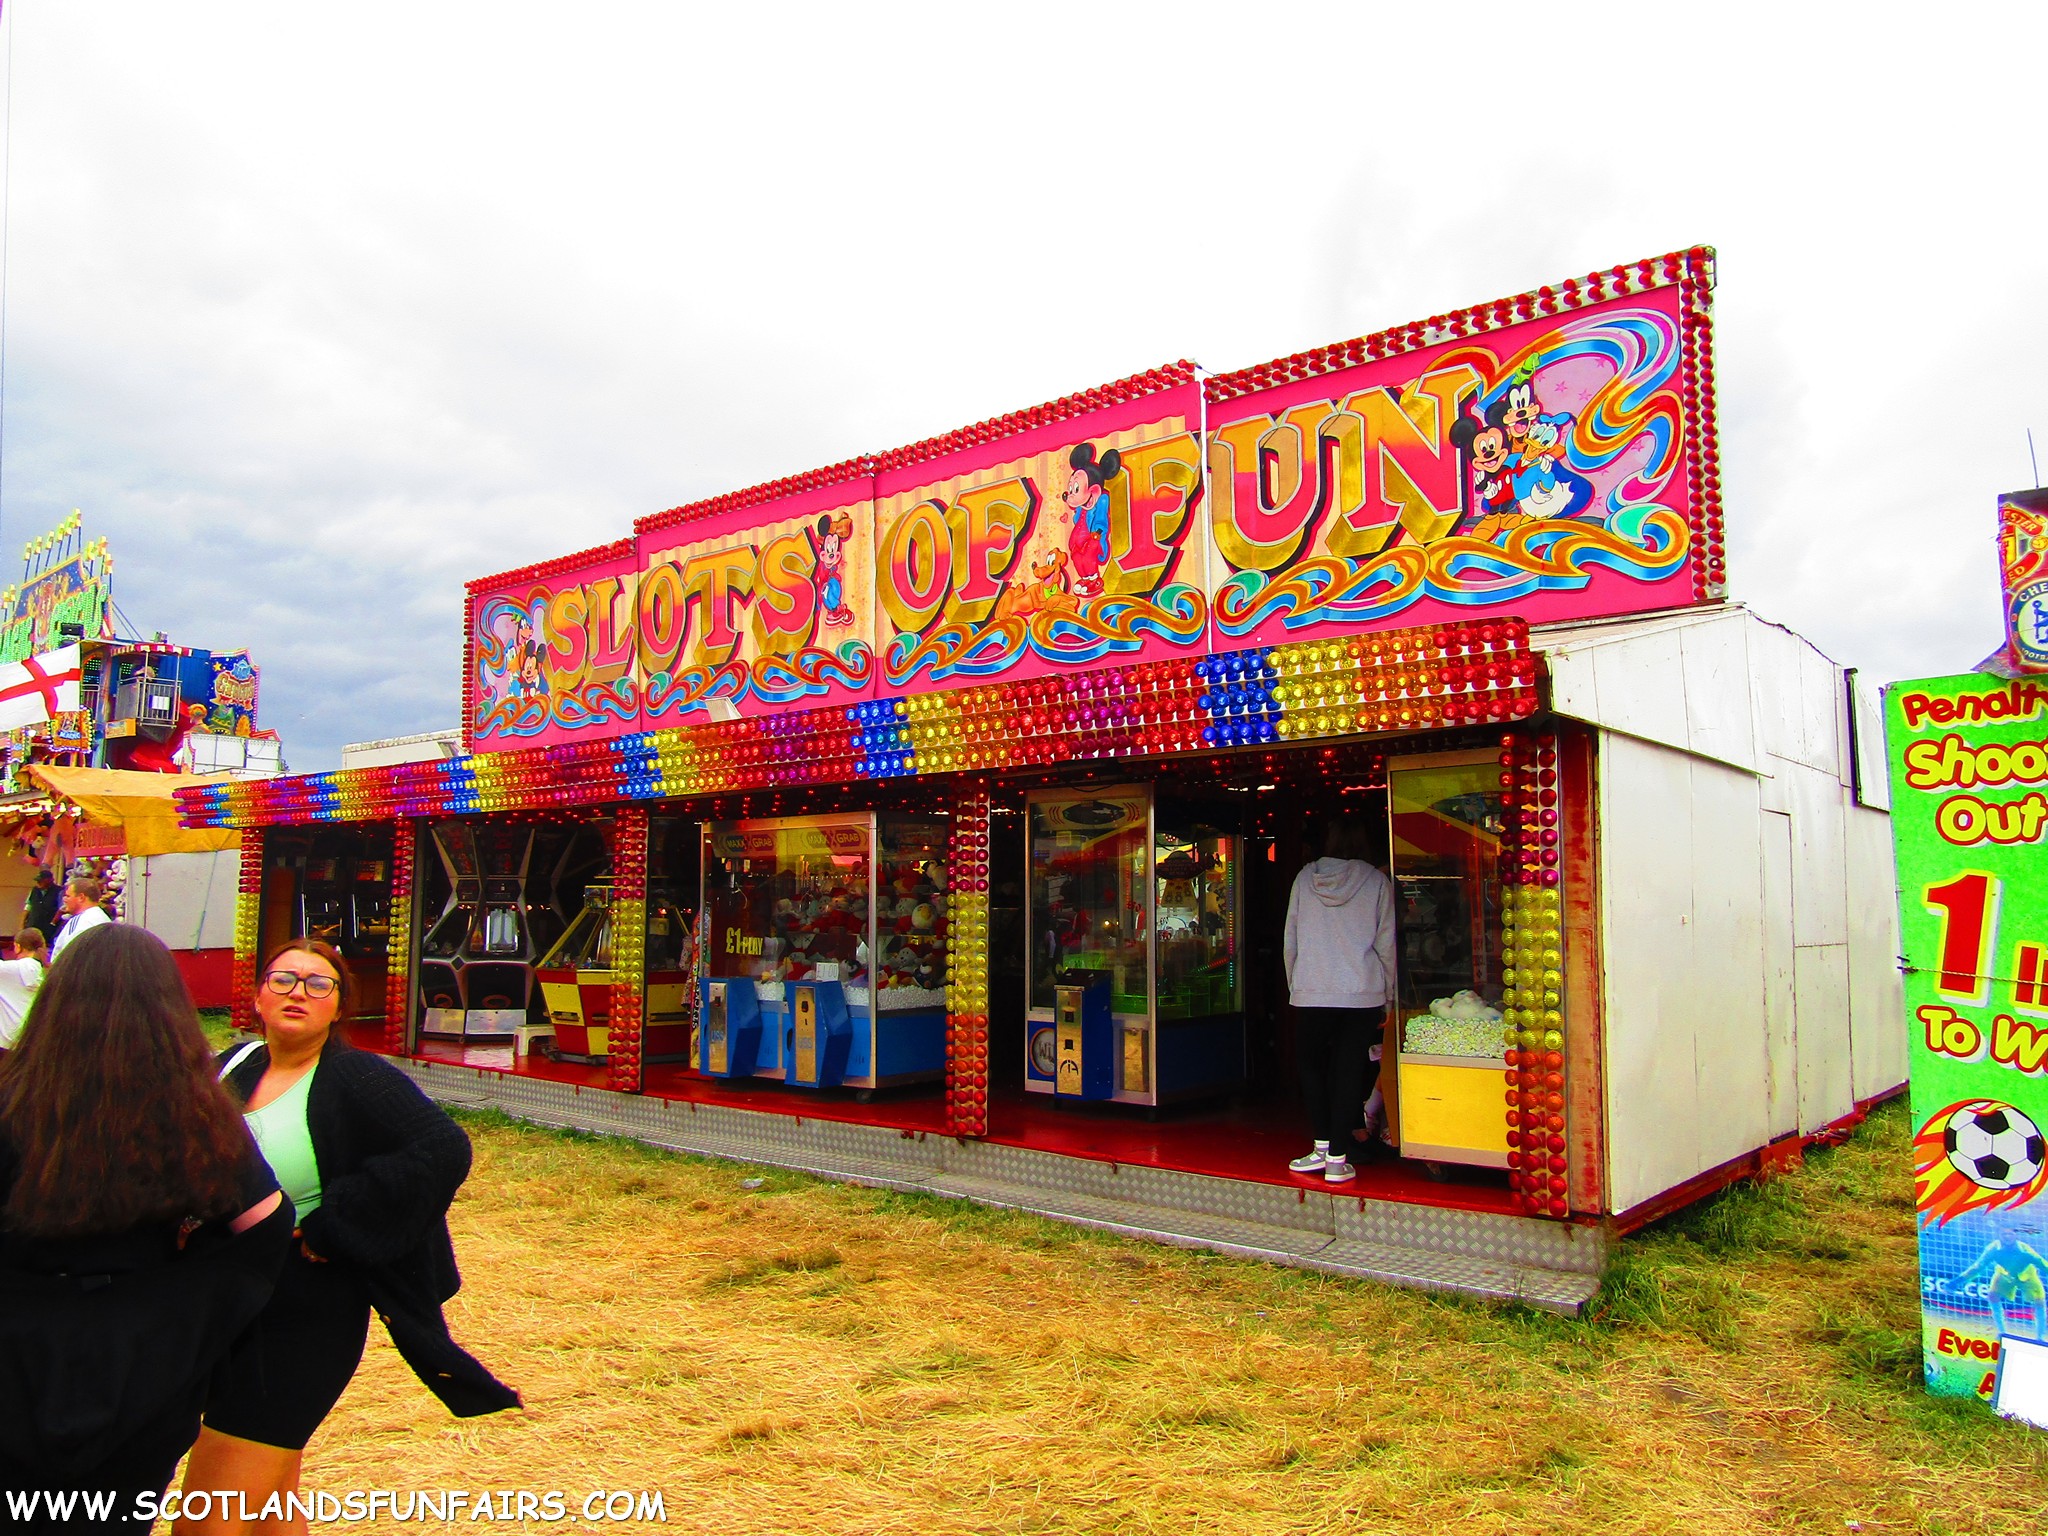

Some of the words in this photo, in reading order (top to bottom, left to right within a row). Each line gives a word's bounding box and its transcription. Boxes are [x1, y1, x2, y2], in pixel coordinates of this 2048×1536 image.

[545, 531, 819, 686] SLOTS
[877, 477, 1037, 632] OF
[1103, 364, 1482, 594] FUN
[2001, 508, 2037, 534] ESTER
[2006, 564, 2026, 583] ED
[2019, 581, 2048, 602] CHE
[2022, 647, 2048, 661] OOTB
[1901, 680, 2048, 728] Penalt
[1904, 734, 2048, 790] Shoo
[1936, 793, 2047, 845] Out
[752, 836, 774, 848] GRAB
[835, 832, 860, 844] GRAB
[1924, 871, 1992, 997] 1
[1917, 1006, 1980, 1057] To
[1990, 1015, 2048, 1073] W
